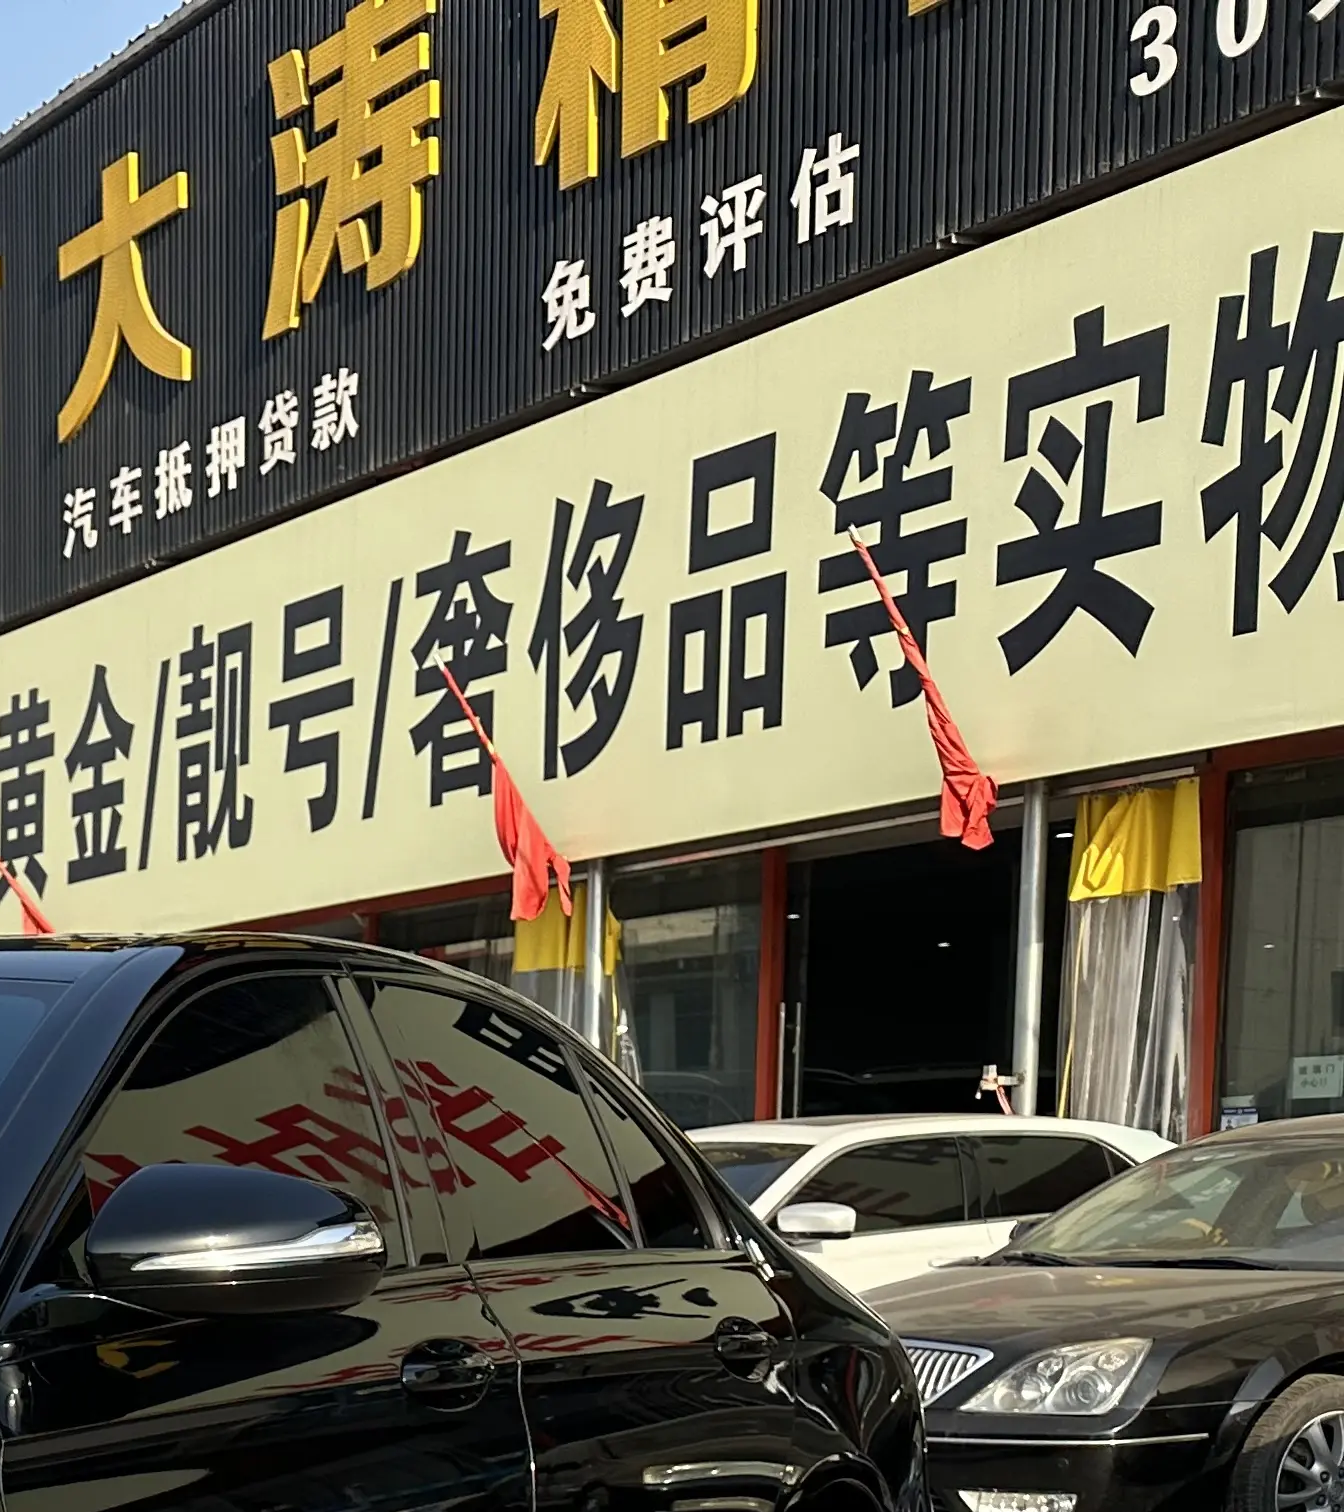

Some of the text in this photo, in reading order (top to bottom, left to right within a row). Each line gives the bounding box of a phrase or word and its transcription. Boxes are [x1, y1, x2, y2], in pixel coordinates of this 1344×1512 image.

[540, 132, 860, 352] 免费评估
[62, 367, 360, 560] 汽车抵押贷款
